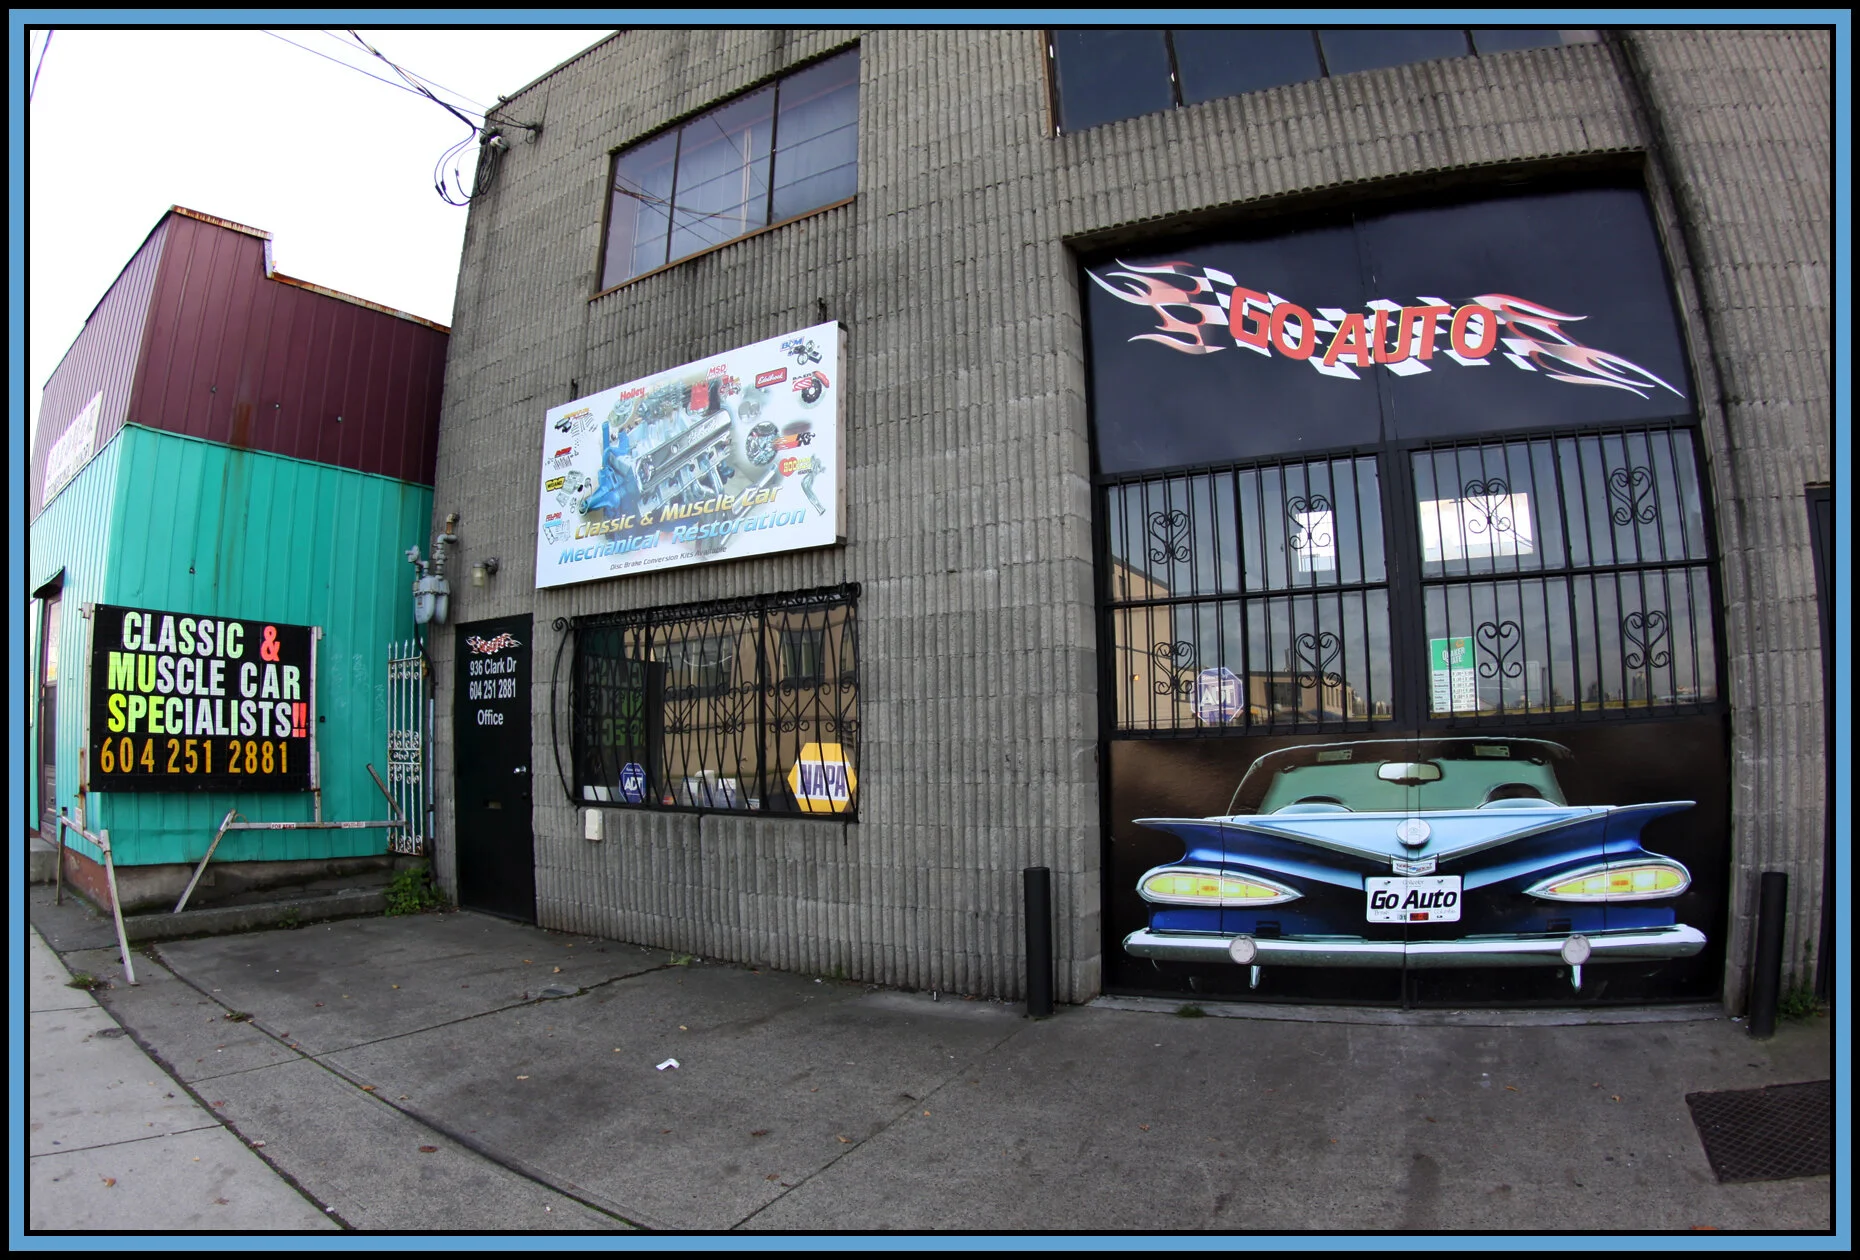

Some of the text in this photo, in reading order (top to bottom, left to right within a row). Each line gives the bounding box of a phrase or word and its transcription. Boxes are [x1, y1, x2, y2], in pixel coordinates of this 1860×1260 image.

[1229, 286, 1498, 367] GO AUTO
[708, 364, 727, 376] MSD
[619, 386, 646, 401] Holley
[575, 485, 783, 540] Classic & Muscle Car
[558, 507, 807, 565] Mechanical Restoration
[610, 545, 727, 571] Disc Brake Conversion Kits Available
[123, 611, 281, 662] CLASSIC &
[108, 651, 300, 700] MUSCLE CAR
[469, 656, 517, 676] 936 Clark Dr
[469, 678, 516, 700] 604 251 2881
[108, 693, 307, 738] SPECIALISTS!!
[477, 709, 504, 726] Office
[101, 737, 288, 774] 604 251 2881
[624, 776, 644, 791] ADT
[800, 764, 846, 797] NAPA
[1370, 889, 1457, 909] Go Auto
